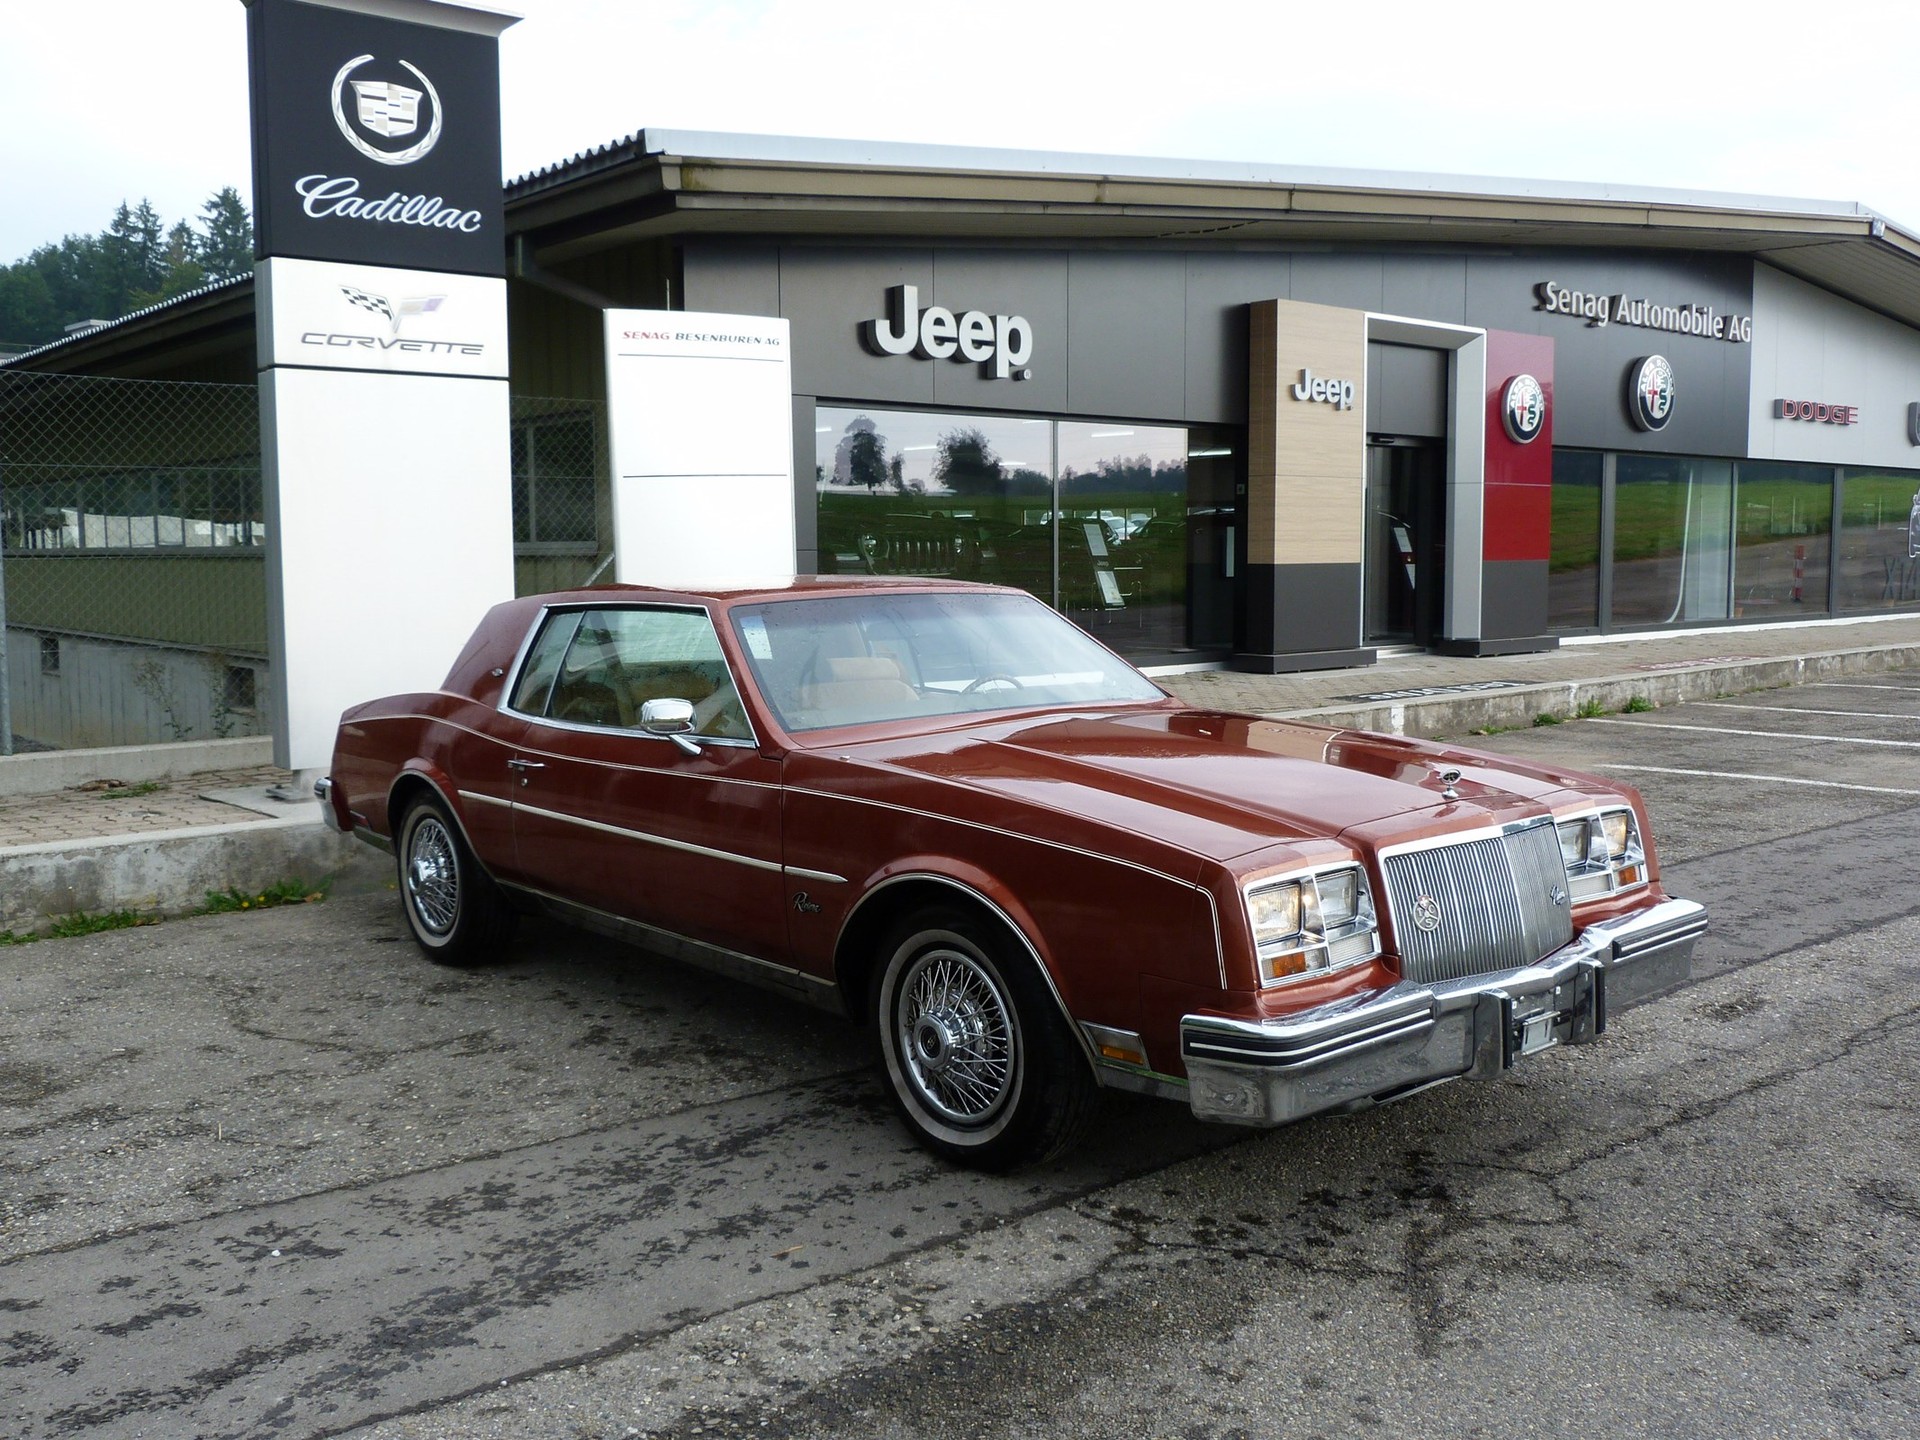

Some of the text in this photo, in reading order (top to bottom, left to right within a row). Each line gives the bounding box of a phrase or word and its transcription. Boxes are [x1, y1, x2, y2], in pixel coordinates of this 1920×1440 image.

[294, 174, 482, 233] Cadillac
[871, 284, 1033, 379] Jeep
[1544, 281, 1751, 343] Senag Automobile AG
[301, 332, 485, 356] CORVETTE
[622, 331, 780, 346] SENAG BESENBUREN AG
[1293, 368, 1355, 410] Jeep
[1781, 399, 1859, 425] DODGE
